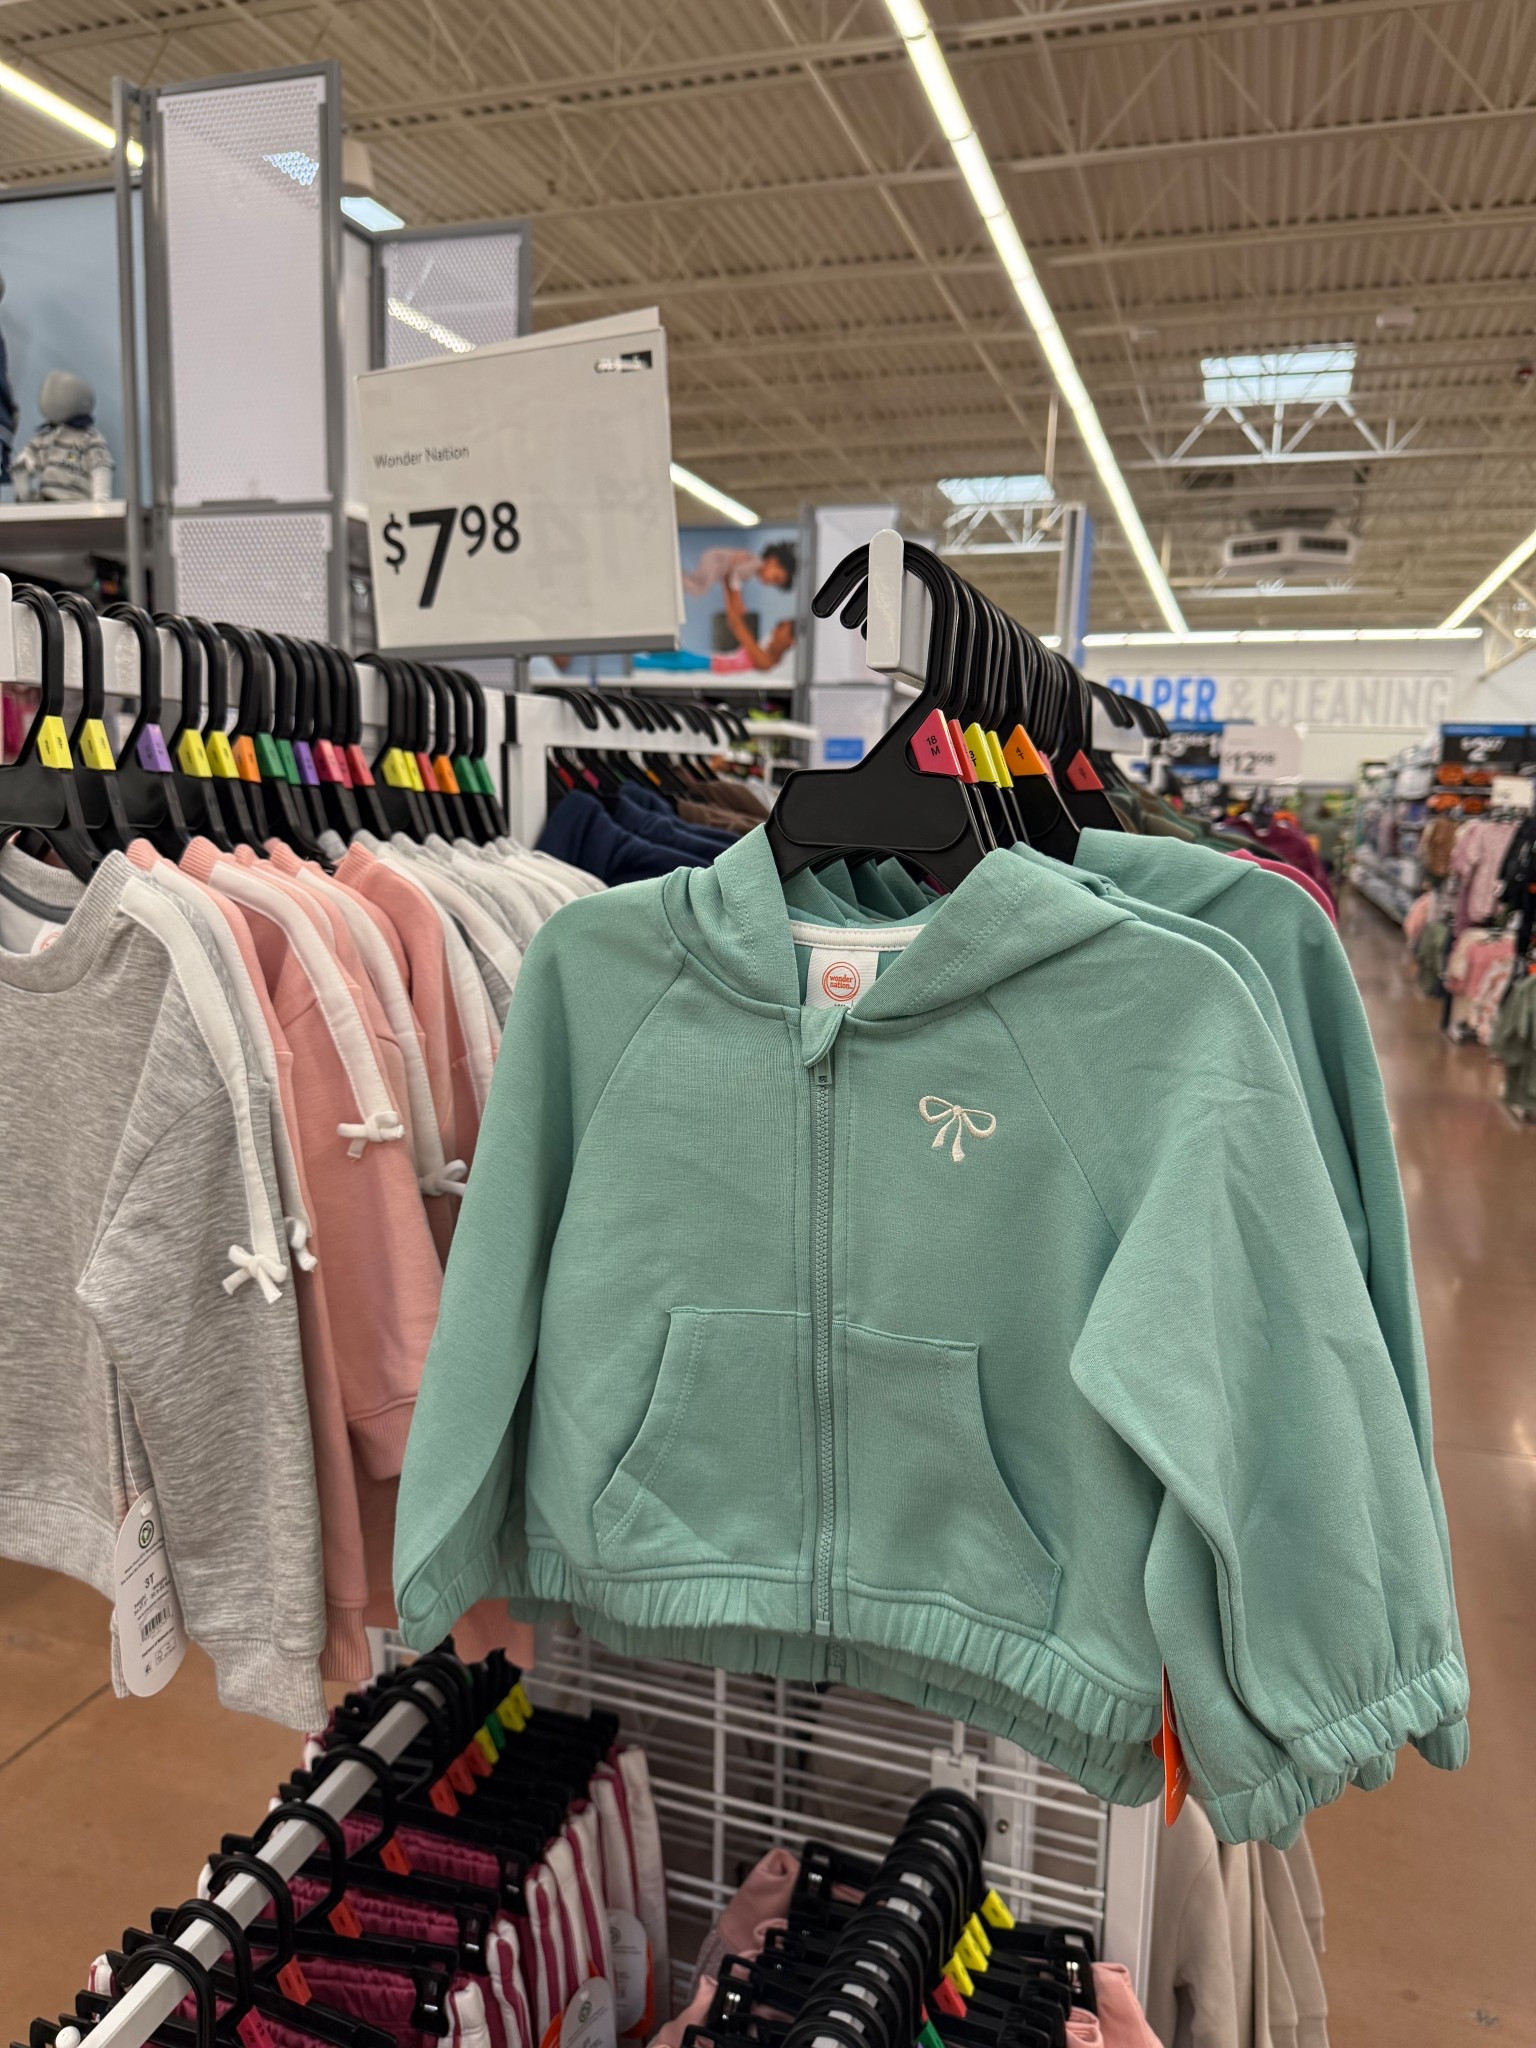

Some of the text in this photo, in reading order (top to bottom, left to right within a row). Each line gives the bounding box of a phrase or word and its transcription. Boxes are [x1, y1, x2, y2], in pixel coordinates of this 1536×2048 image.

[373, 446, 470, 469] Wonder Nation
[1226, 678, 1253, 721] &
[1264, 678, 1448, 724] CLEANING
[926, 735, 938, 745] 18
[930, 746, 941, 757] M
[830, 974, 853, 983] wonder
